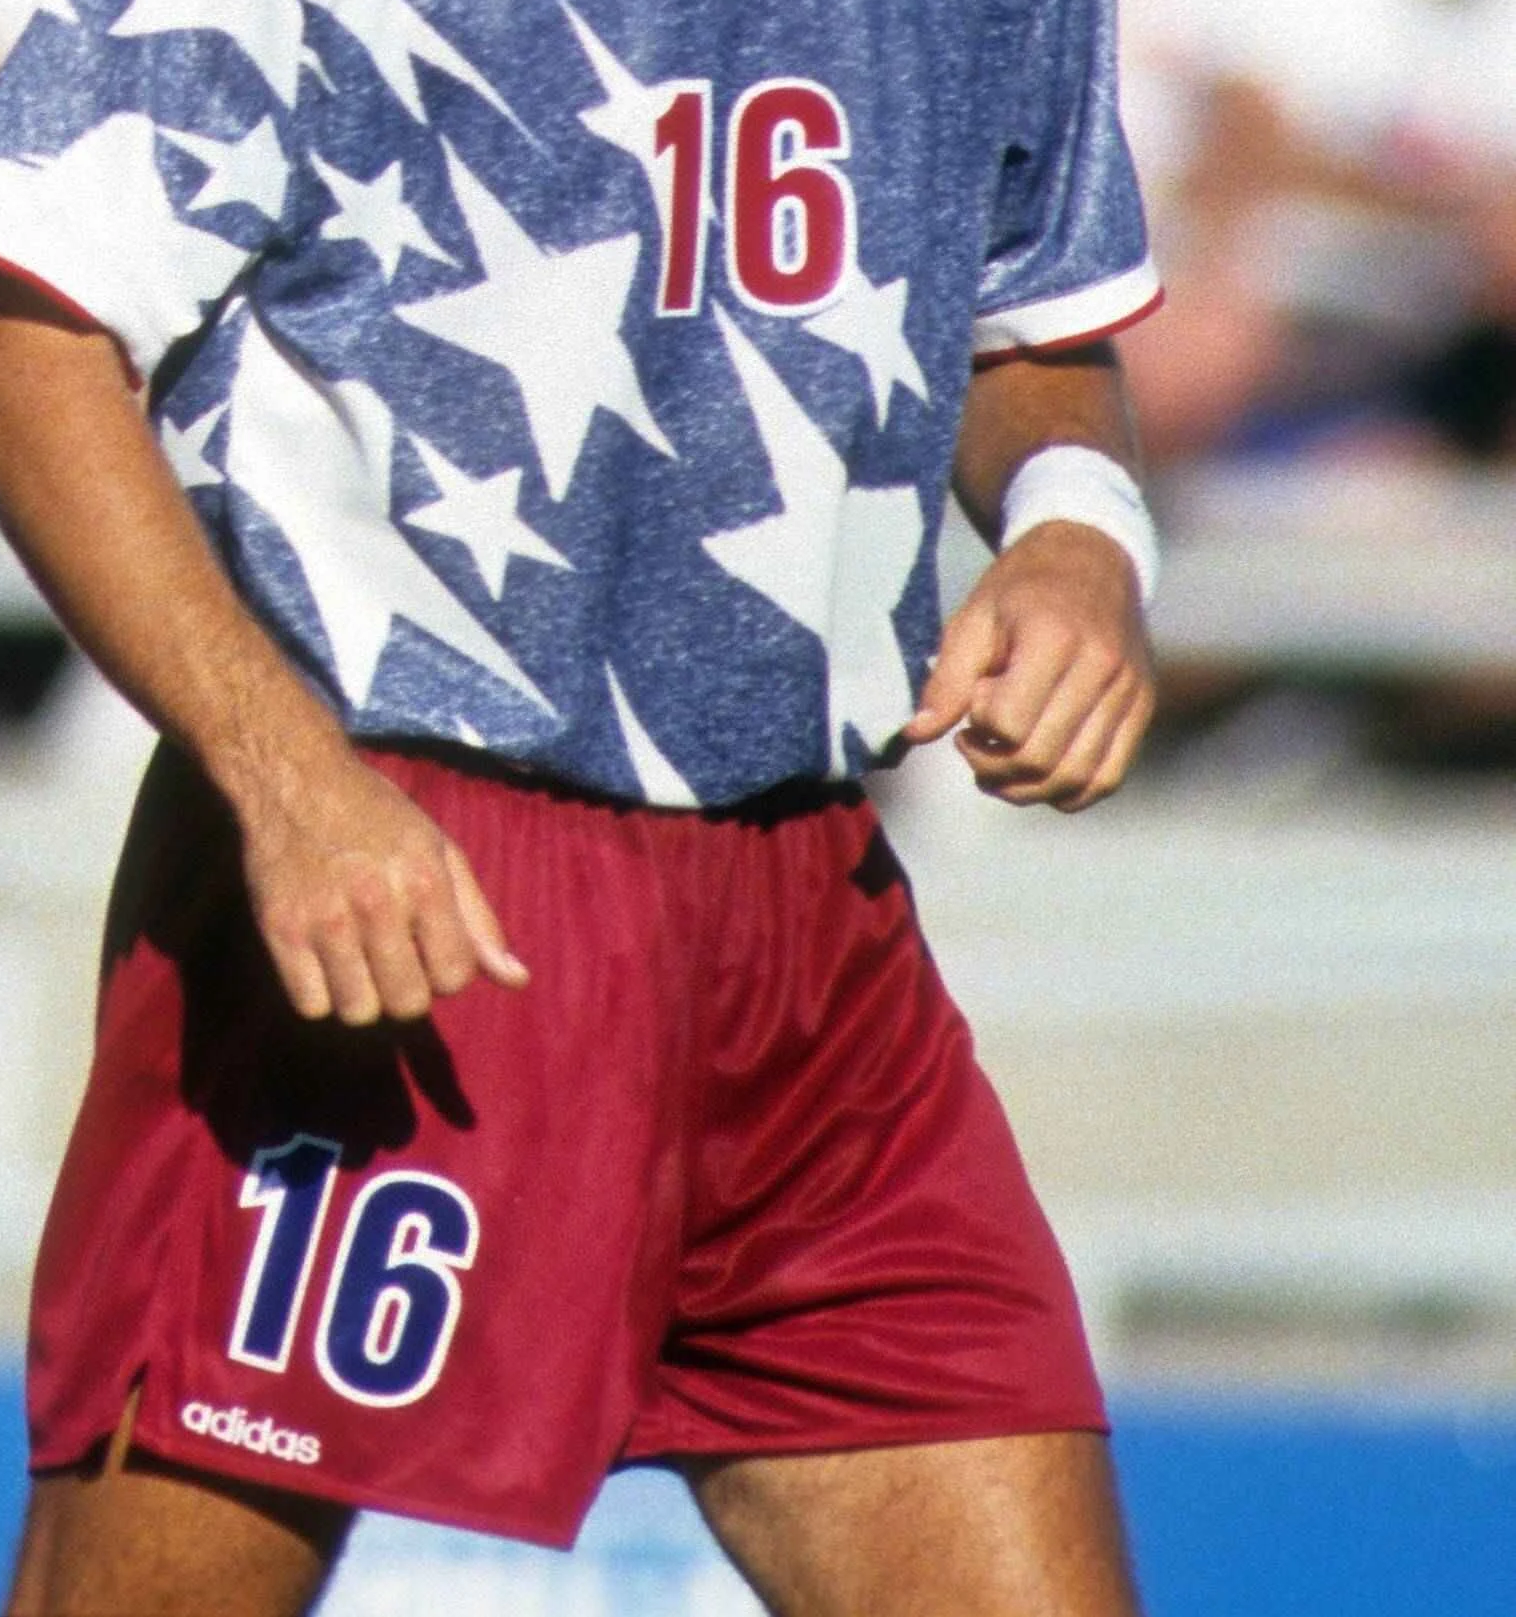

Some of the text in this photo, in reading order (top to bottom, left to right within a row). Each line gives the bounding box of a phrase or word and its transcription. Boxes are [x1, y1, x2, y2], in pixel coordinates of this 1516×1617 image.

[650, 76, 858, 318] 16
[228, 1132, 481, 1408] 16
[181, 1400, 322, 1465] adidas
